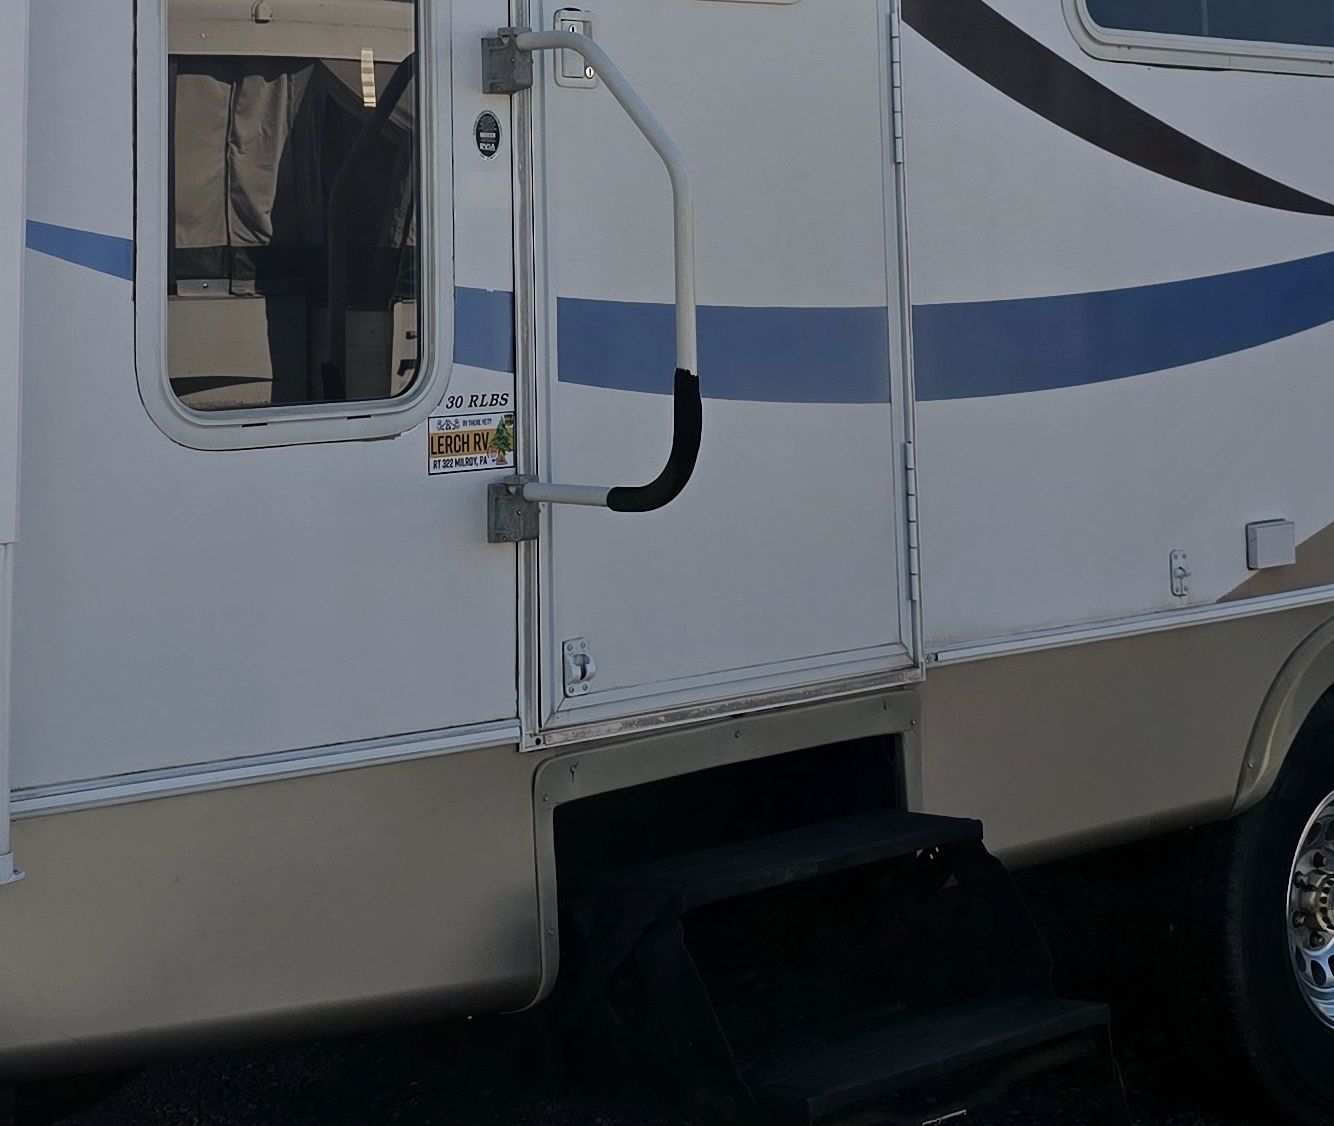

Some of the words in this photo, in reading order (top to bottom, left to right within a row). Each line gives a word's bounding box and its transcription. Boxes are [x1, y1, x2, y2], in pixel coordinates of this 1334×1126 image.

[446, 395, 463, 409] 30
[468, 393, 509, 408] RLBS
[430, 434, 469, 455] LERCH
[474, 432, 489, 451] RV
[433, 460, 441, 469] RT
[442, 458, 454, 469] 322
[480, 456, 488, 465] PA
